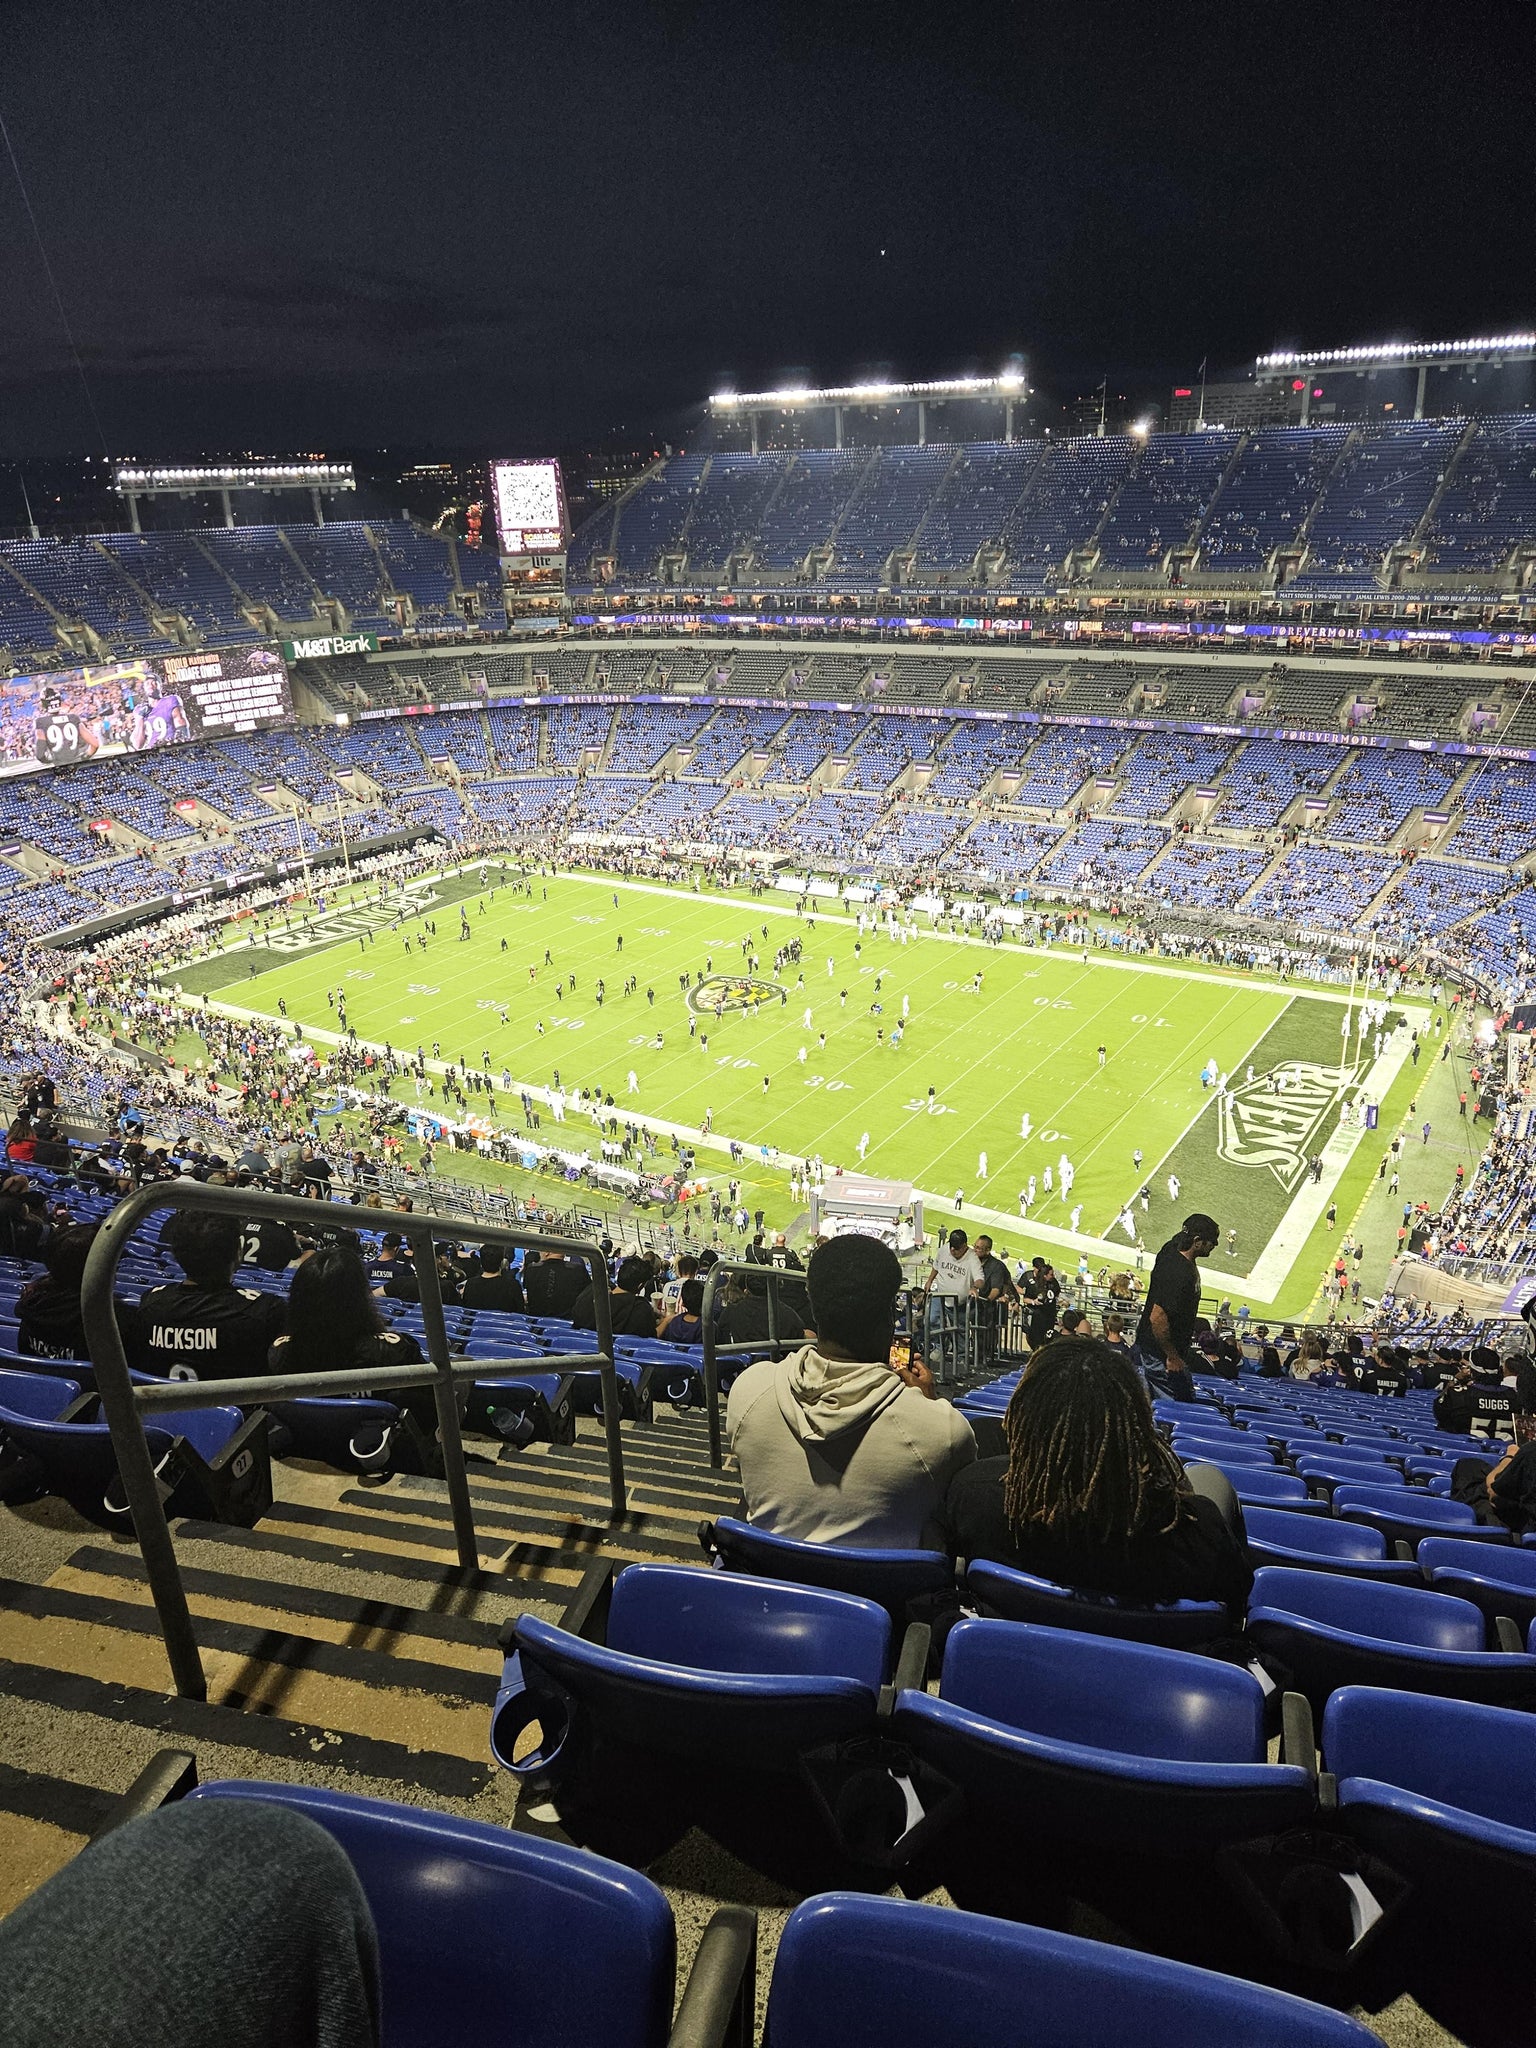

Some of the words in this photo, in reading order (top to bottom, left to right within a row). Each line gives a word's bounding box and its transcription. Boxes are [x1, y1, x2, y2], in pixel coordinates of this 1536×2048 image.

[1498, 634, 1510, 643] 30
[292, 637, 332, 659] M&T
[333, 634, 371, 654] Bank
[1055, 715, 1091, 725] SEASONS
[47, 722, 79, 751] 99
[1202, 726, 1242, 735] RAVENS
[1464, 745, 1477, 754] 30
[1481, 747, 1530, 759] SEASONS
[370, 1270, 393, 1279] JACKSON
[149, 1324, 217, 1350] JACKSON
[1478, 1397, 1510, 1411] SUGGS
[236, 1454, 247, 1473] 27
